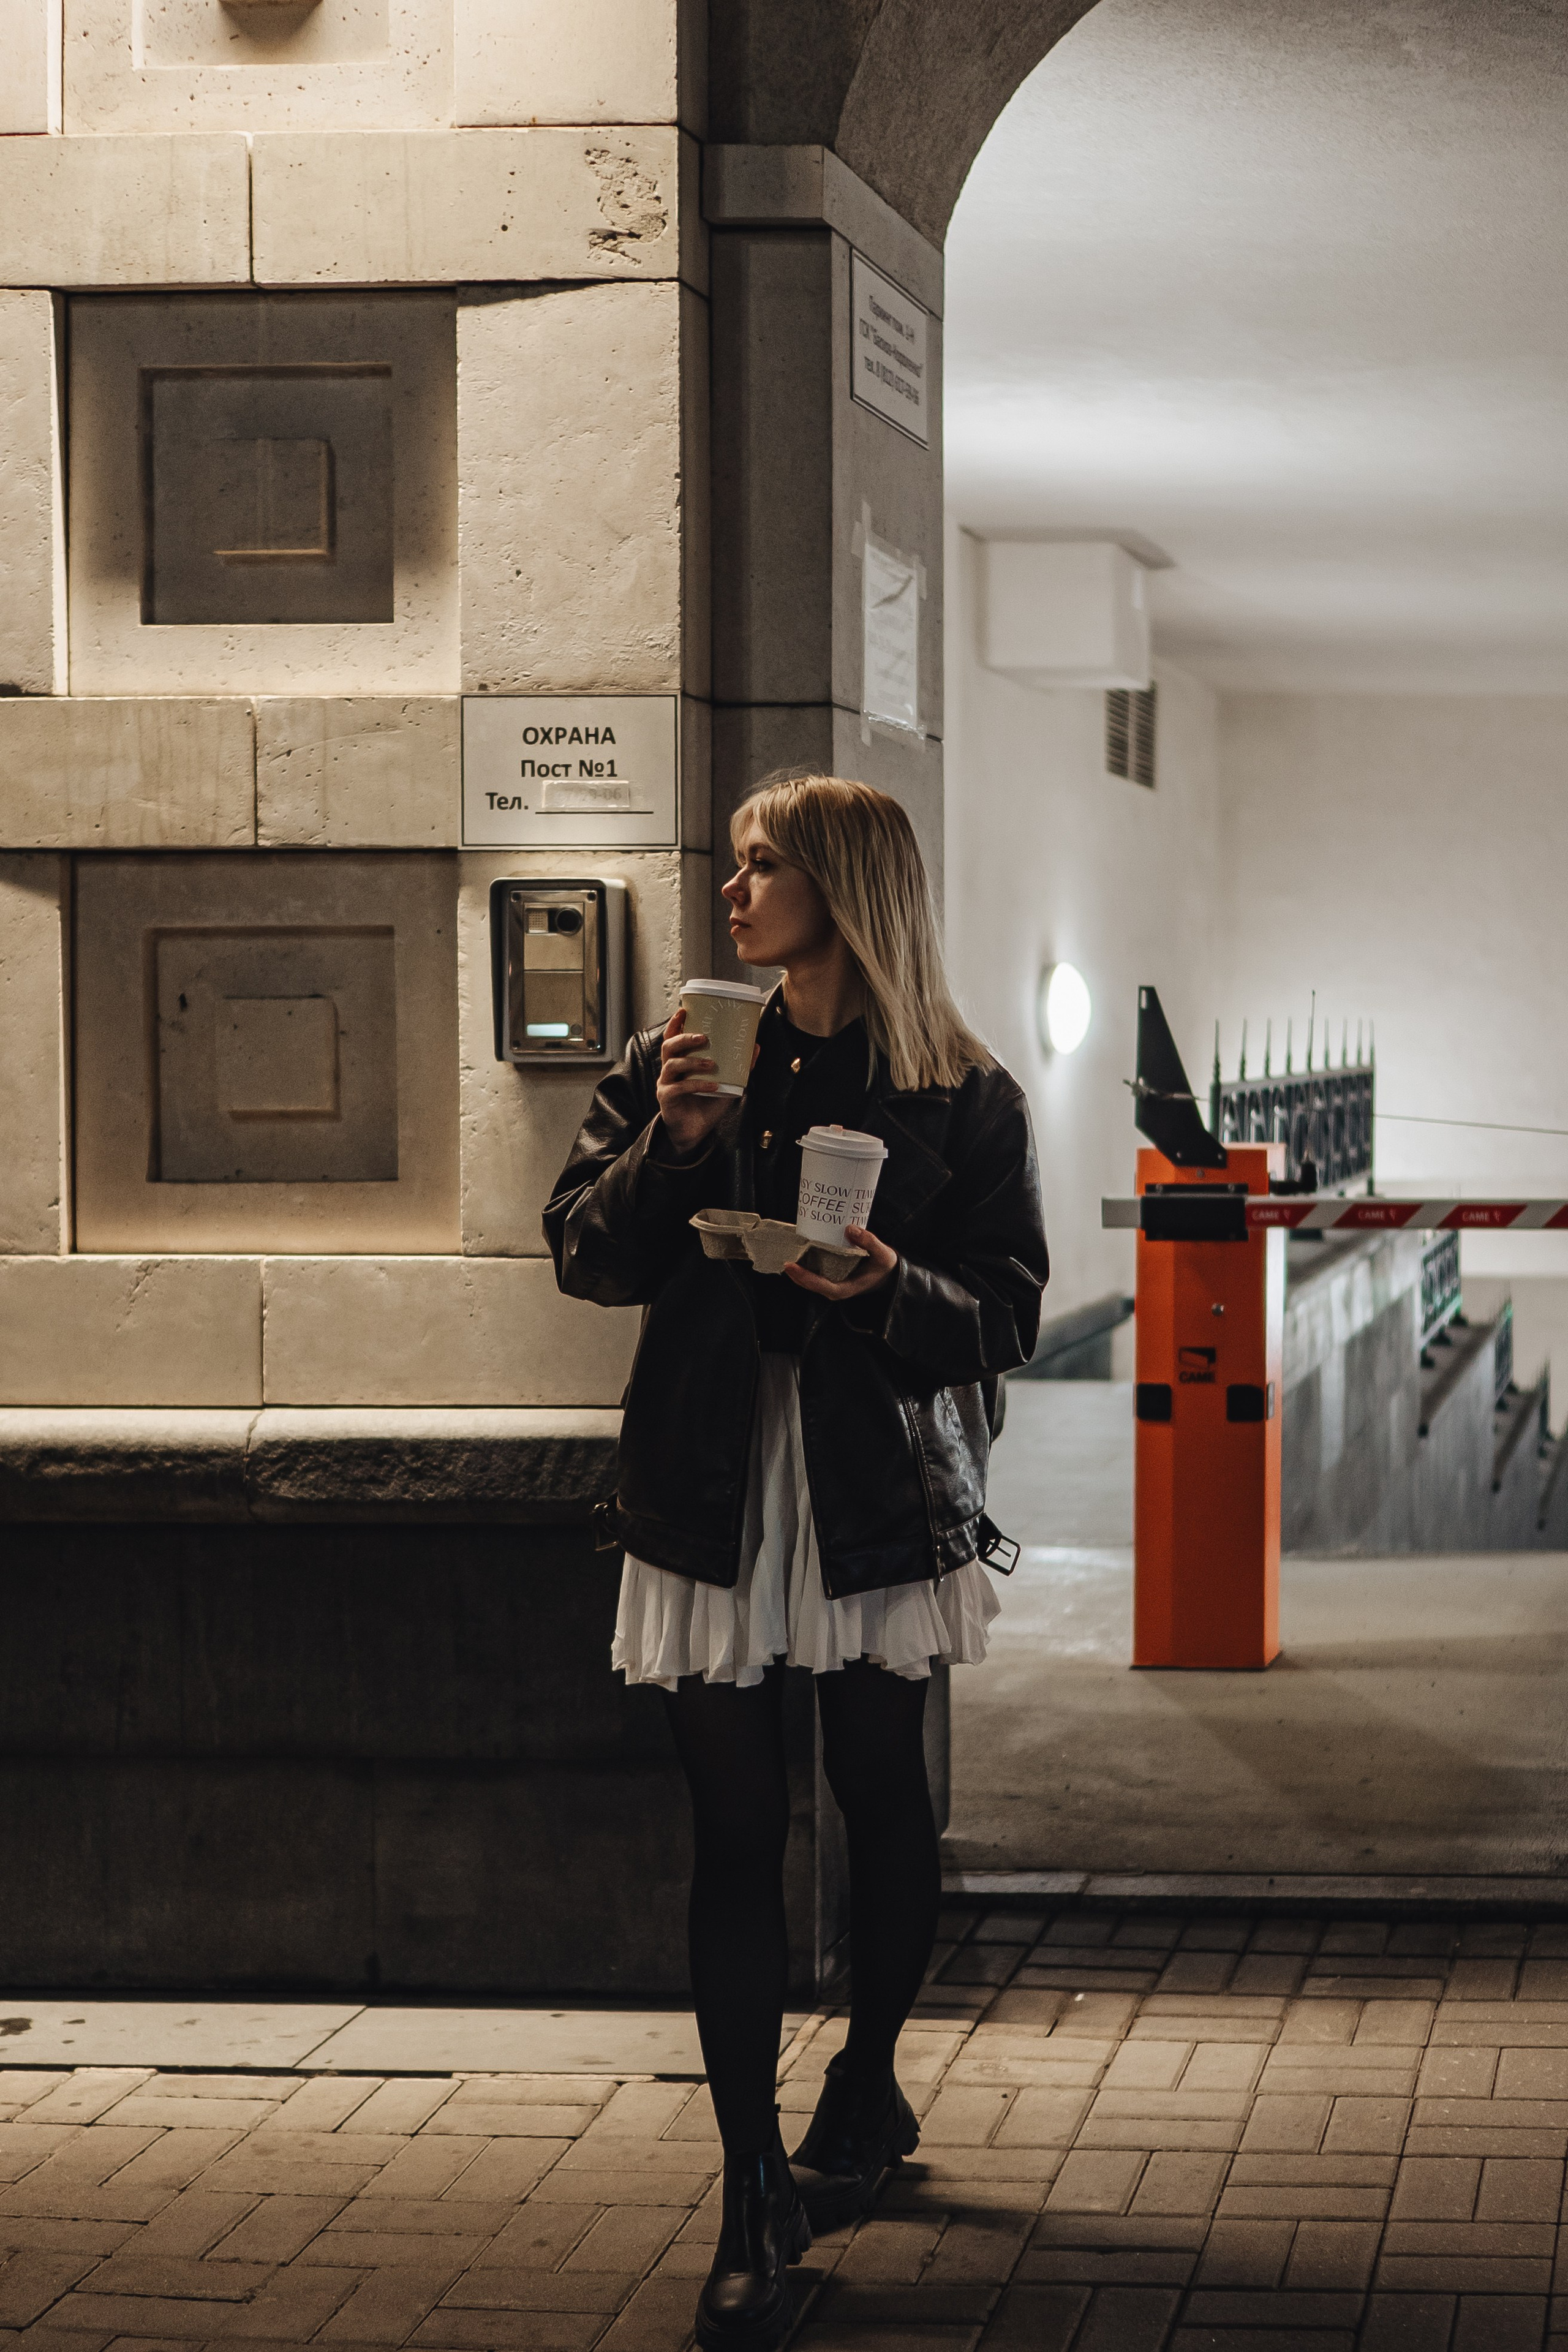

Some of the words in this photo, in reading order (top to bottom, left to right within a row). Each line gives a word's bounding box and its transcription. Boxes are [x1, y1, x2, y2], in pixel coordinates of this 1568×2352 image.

[522, 726, 616, 745] ОХРАНА
[521, 760, 572, 777] Пост
[579, 759, 617, 777] №1
[485, 792, 529, 810] Тел.
[814, 1182, 851, 1198] SLOW
[810, 1210, 846, 1225] SLOW
[1251, 1209, 1280, 1221] CAME
[1358, 1210, 1385, 1221] CAME
[1462, 1210, 1490, 1223] CAME
[1178, 1371, 1215, 1384] CAME
